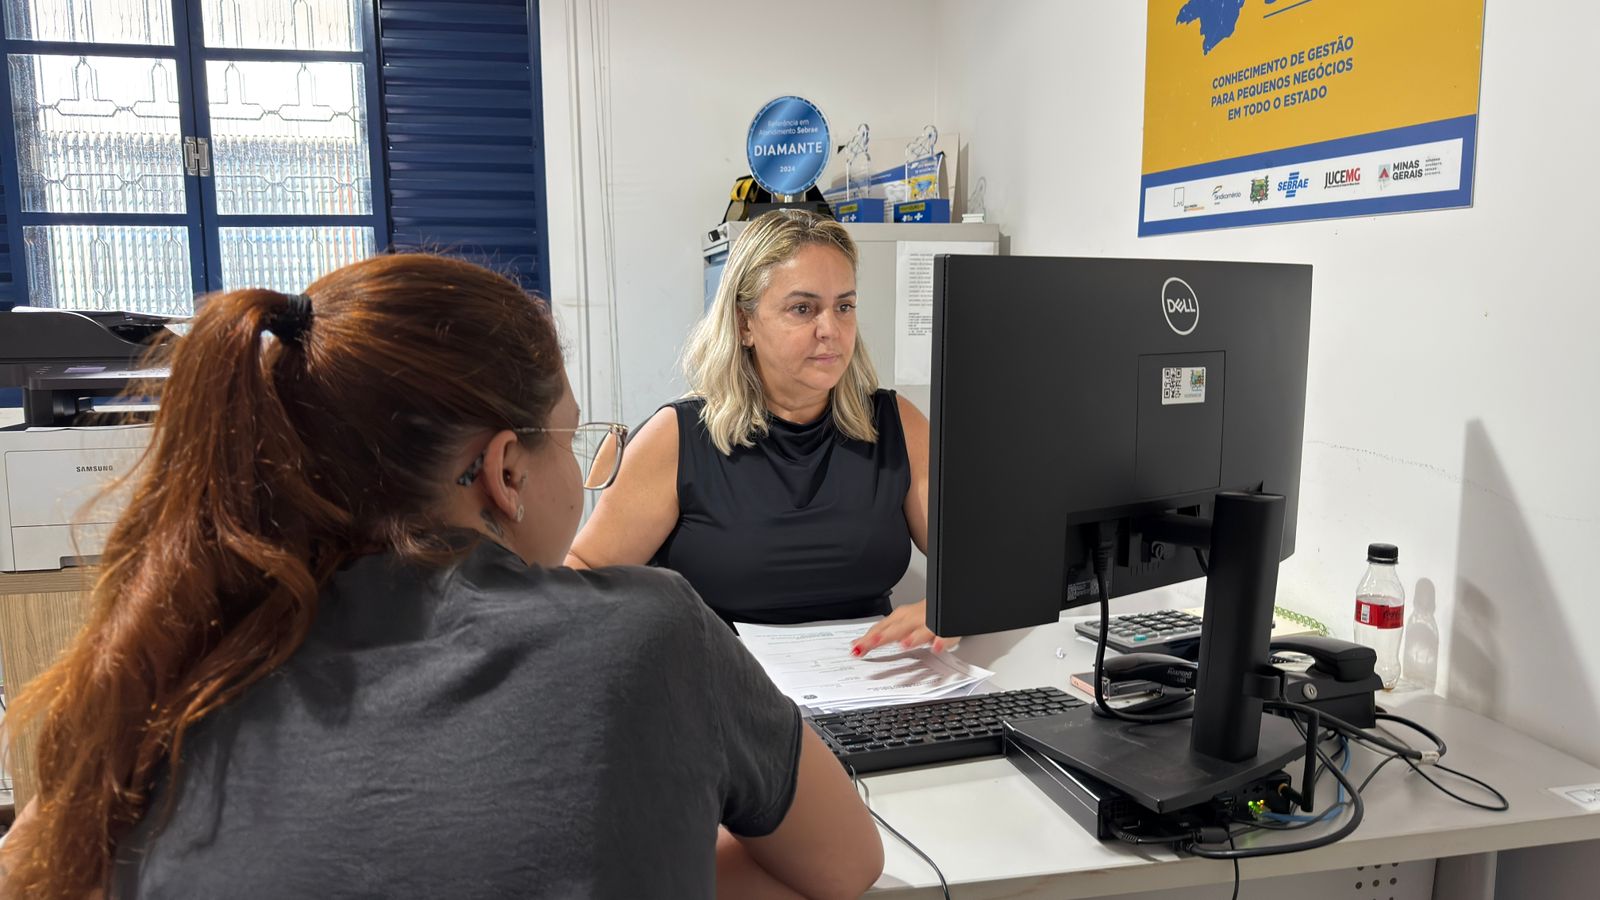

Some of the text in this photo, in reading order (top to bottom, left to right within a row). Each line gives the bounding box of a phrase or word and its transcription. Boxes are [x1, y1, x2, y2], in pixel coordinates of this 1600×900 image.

[1212, 35, 1354, 90] CONHECIMENTO DE GESTÃO
[1211, 57, 1354, 108] PARA PEQUENOS NEGÓCIOS
[1228, 85, 1328, 121] EM TODO O ESTADO
[797, 126, 818, 134] Sebrae
[754, 142, 822, 156] DIAMANTE
[1392, 159, 1420, 172] MINAS
[1324, 168, 1360, 189] JUCEMG
[1392, 168, 1423, 181] GERAIS
[1277, 178, 1309, 192] SEBRAE
[1166, 298, 1196, 313] DELL
